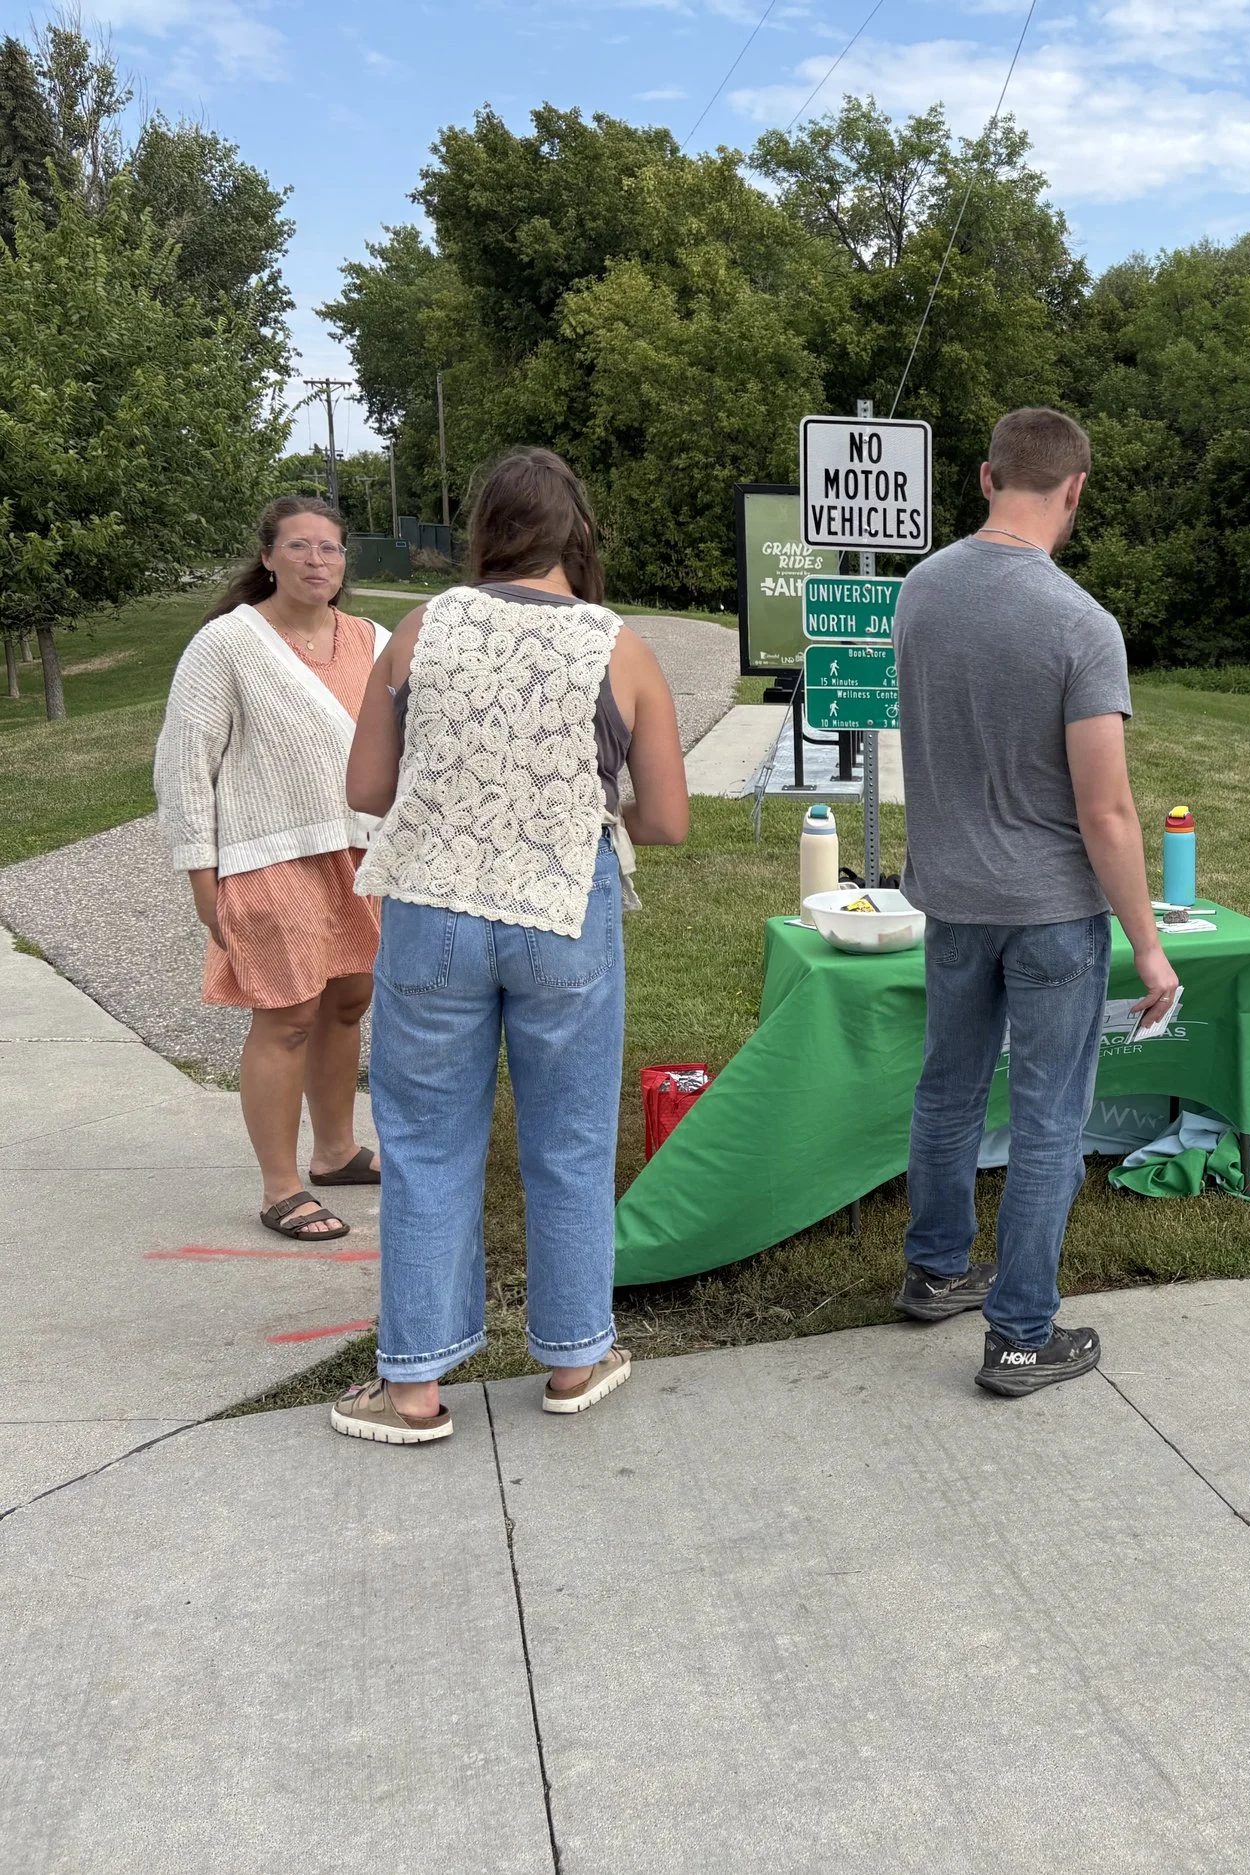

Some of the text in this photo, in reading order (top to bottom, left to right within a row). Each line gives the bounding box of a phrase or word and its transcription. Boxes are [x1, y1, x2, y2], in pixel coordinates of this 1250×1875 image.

[850, 432, 883, 464] NO
[824, 468, 908, 502] MOTOR
[811, 504, 922, 540] VEHICLES
[762, 541, 813, 556] GRAND
[779, 555, 824, 570] RIDES
[774, 577, 803, 597] Alt
[809, 584, 893, 604] UNIVERSITY
[809, 614, 856, 633] NORTH
[820, 677, 859, 687] 15 Minutes
[836, 690, 898, 699] Wellness Cente
[821, 719, 859, 727] 10 Minutes
[1100, 1027, 1187, 1046] AQAS
[1098, 1044, 1143, 1058] ENTER
[1000, 1351, 1037, 1365] HOKA
